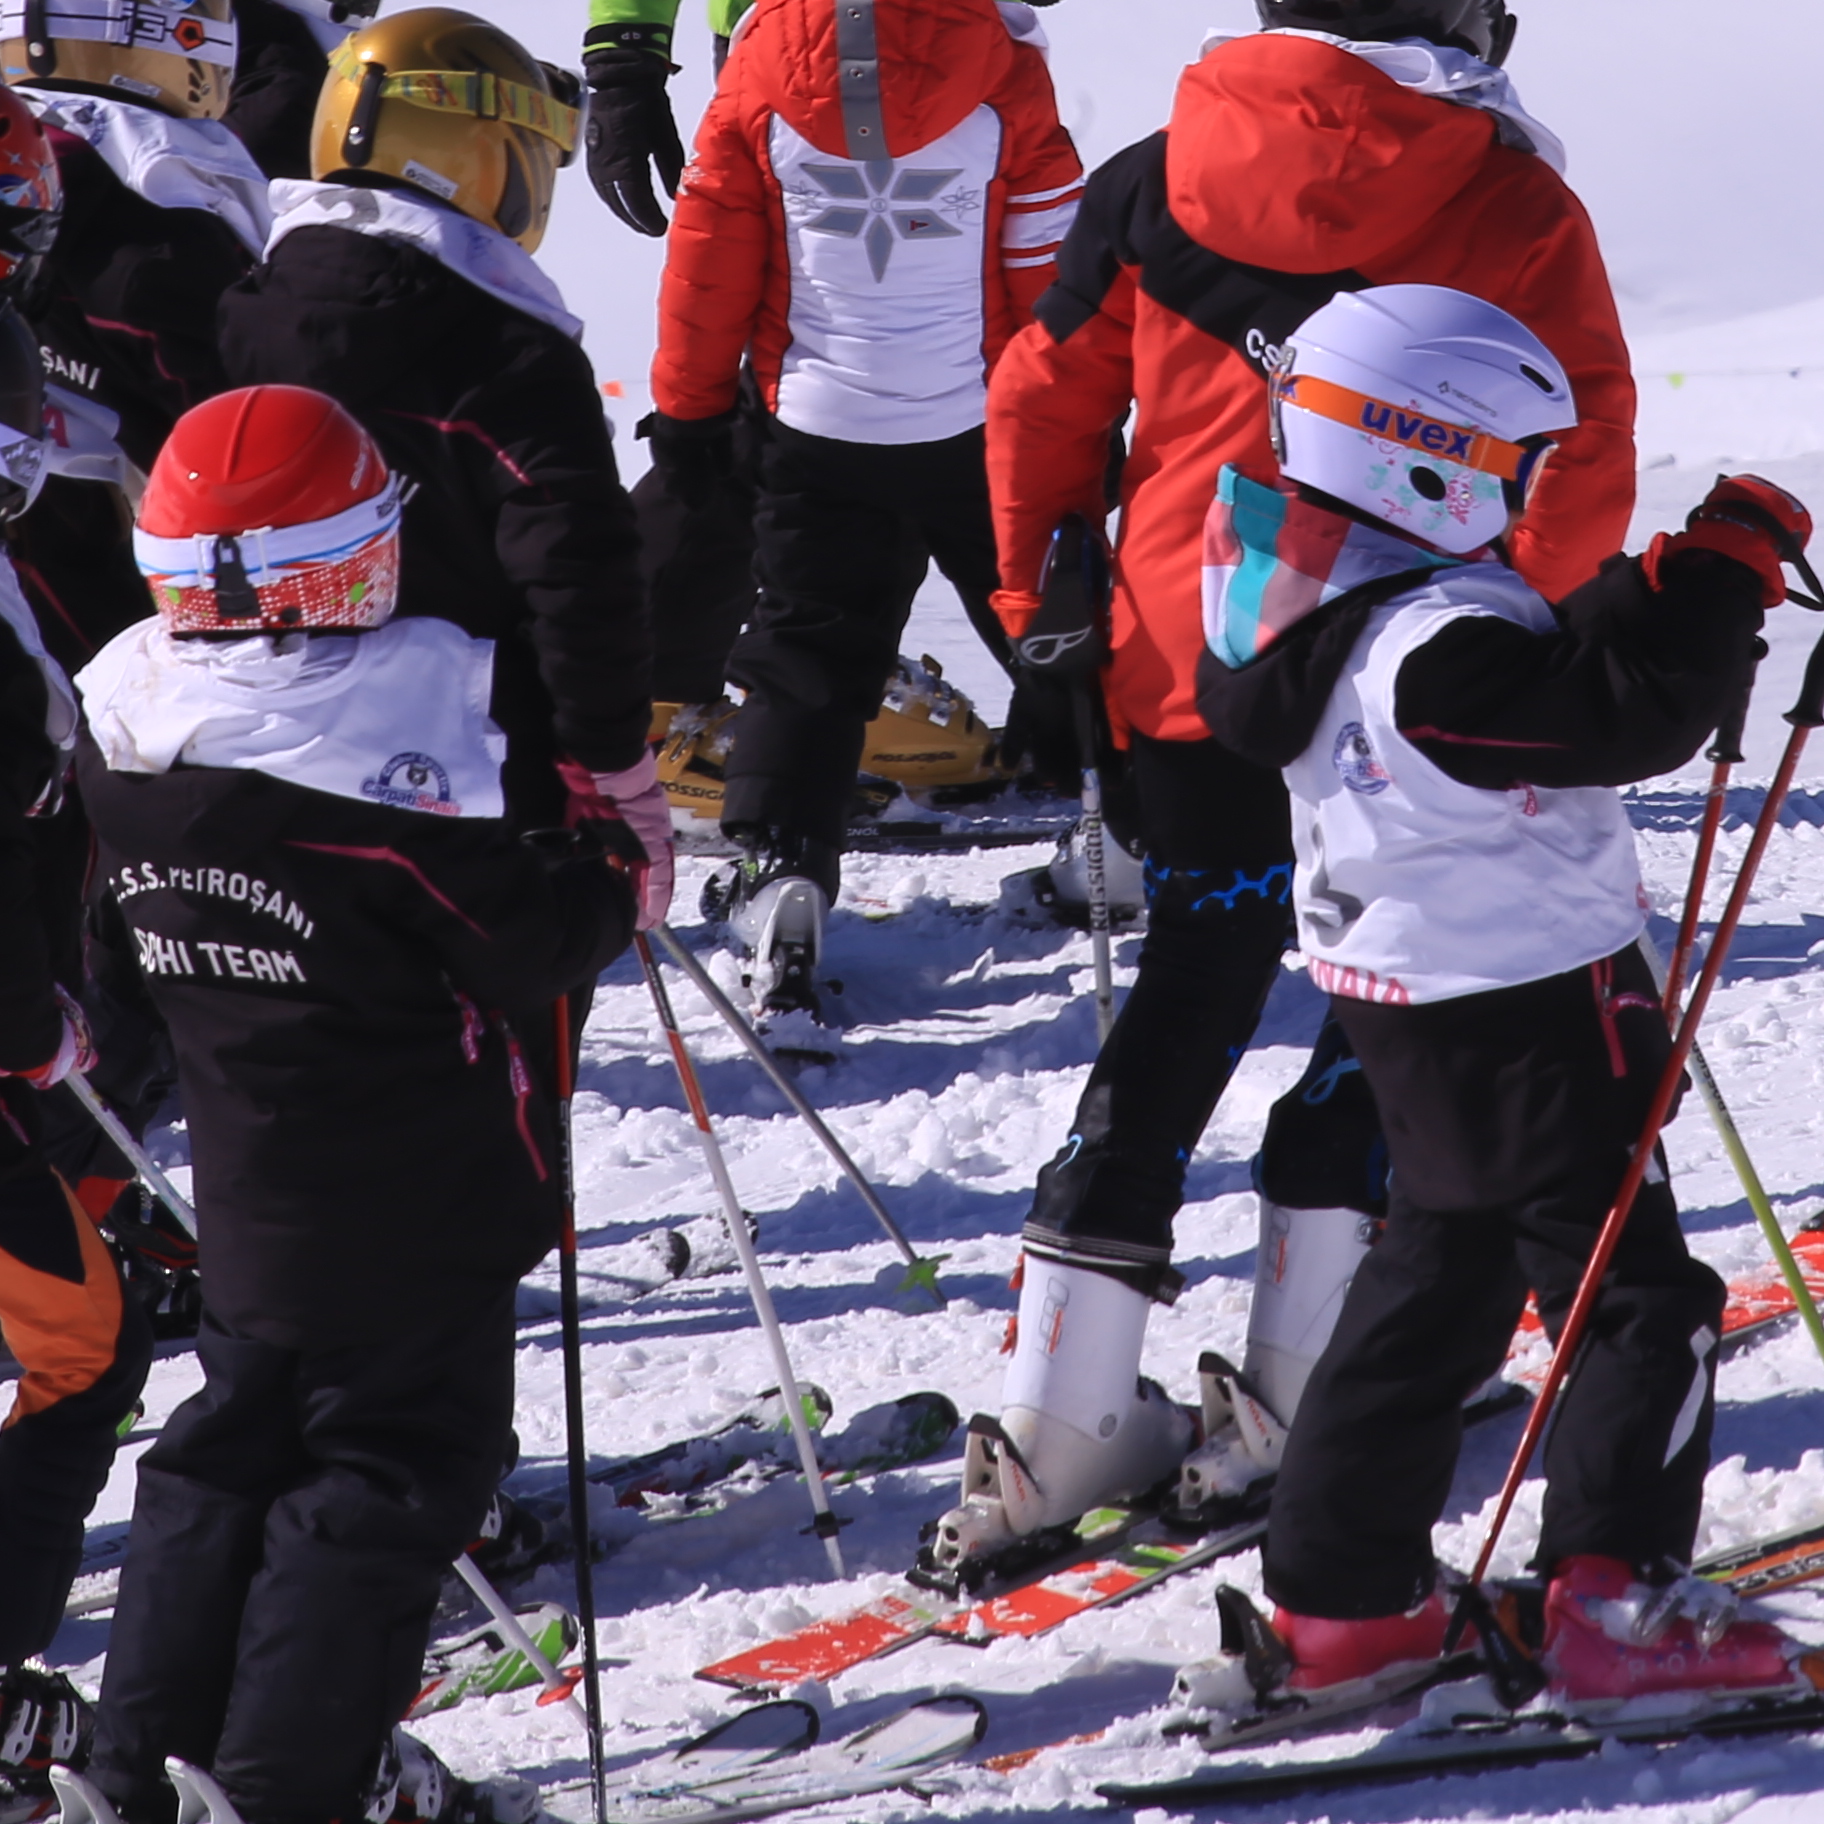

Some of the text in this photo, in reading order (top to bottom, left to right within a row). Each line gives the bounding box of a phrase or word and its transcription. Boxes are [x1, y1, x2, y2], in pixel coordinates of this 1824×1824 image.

[1360, 400, 1474, 460] uvex
[133, 926, 307, 983] SCHI TEAM
